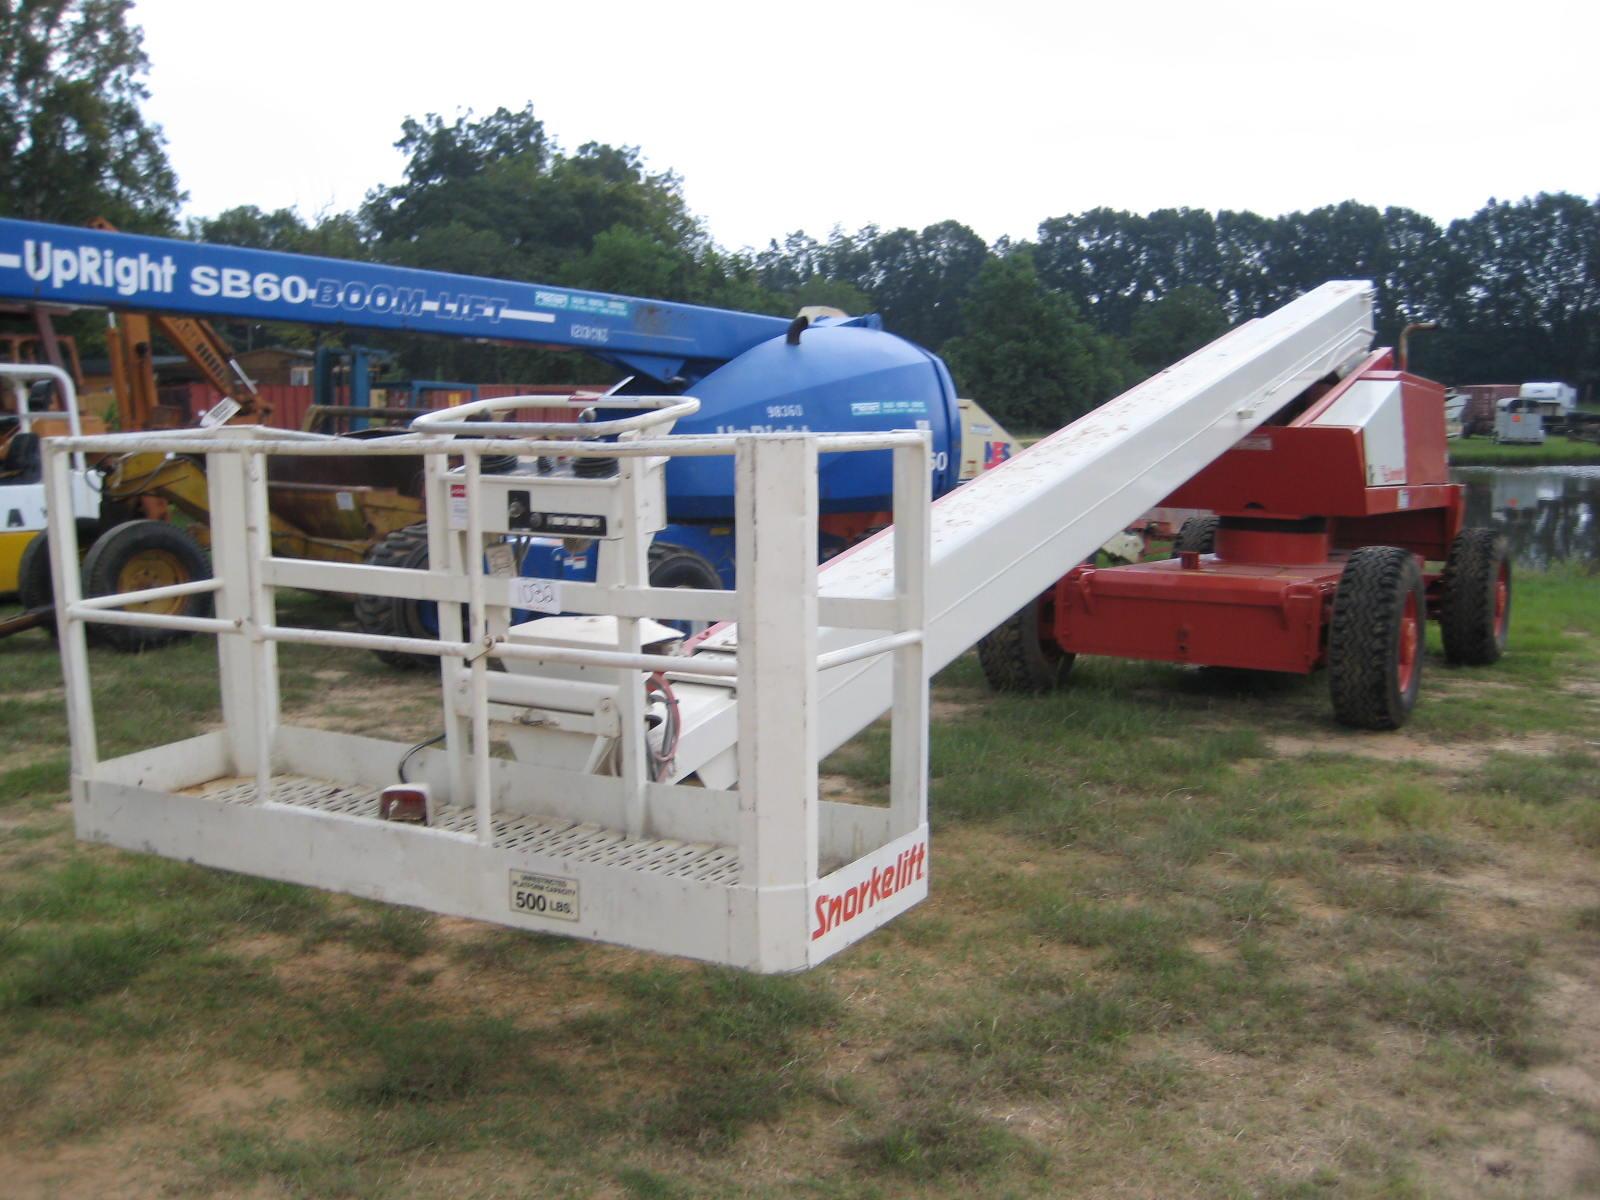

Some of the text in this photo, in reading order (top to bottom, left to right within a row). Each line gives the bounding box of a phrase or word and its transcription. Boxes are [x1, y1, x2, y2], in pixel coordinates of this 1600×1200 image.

[24, 240, 176, 296] UpRight
[190, 265, 308, 304] SB60
[312, 278, 427, 317] BOOM
[435, 291, 508, 324] LIFT
[515, 891, 547, 913] 500
[811, 842, 925, 941] Snorkelift
